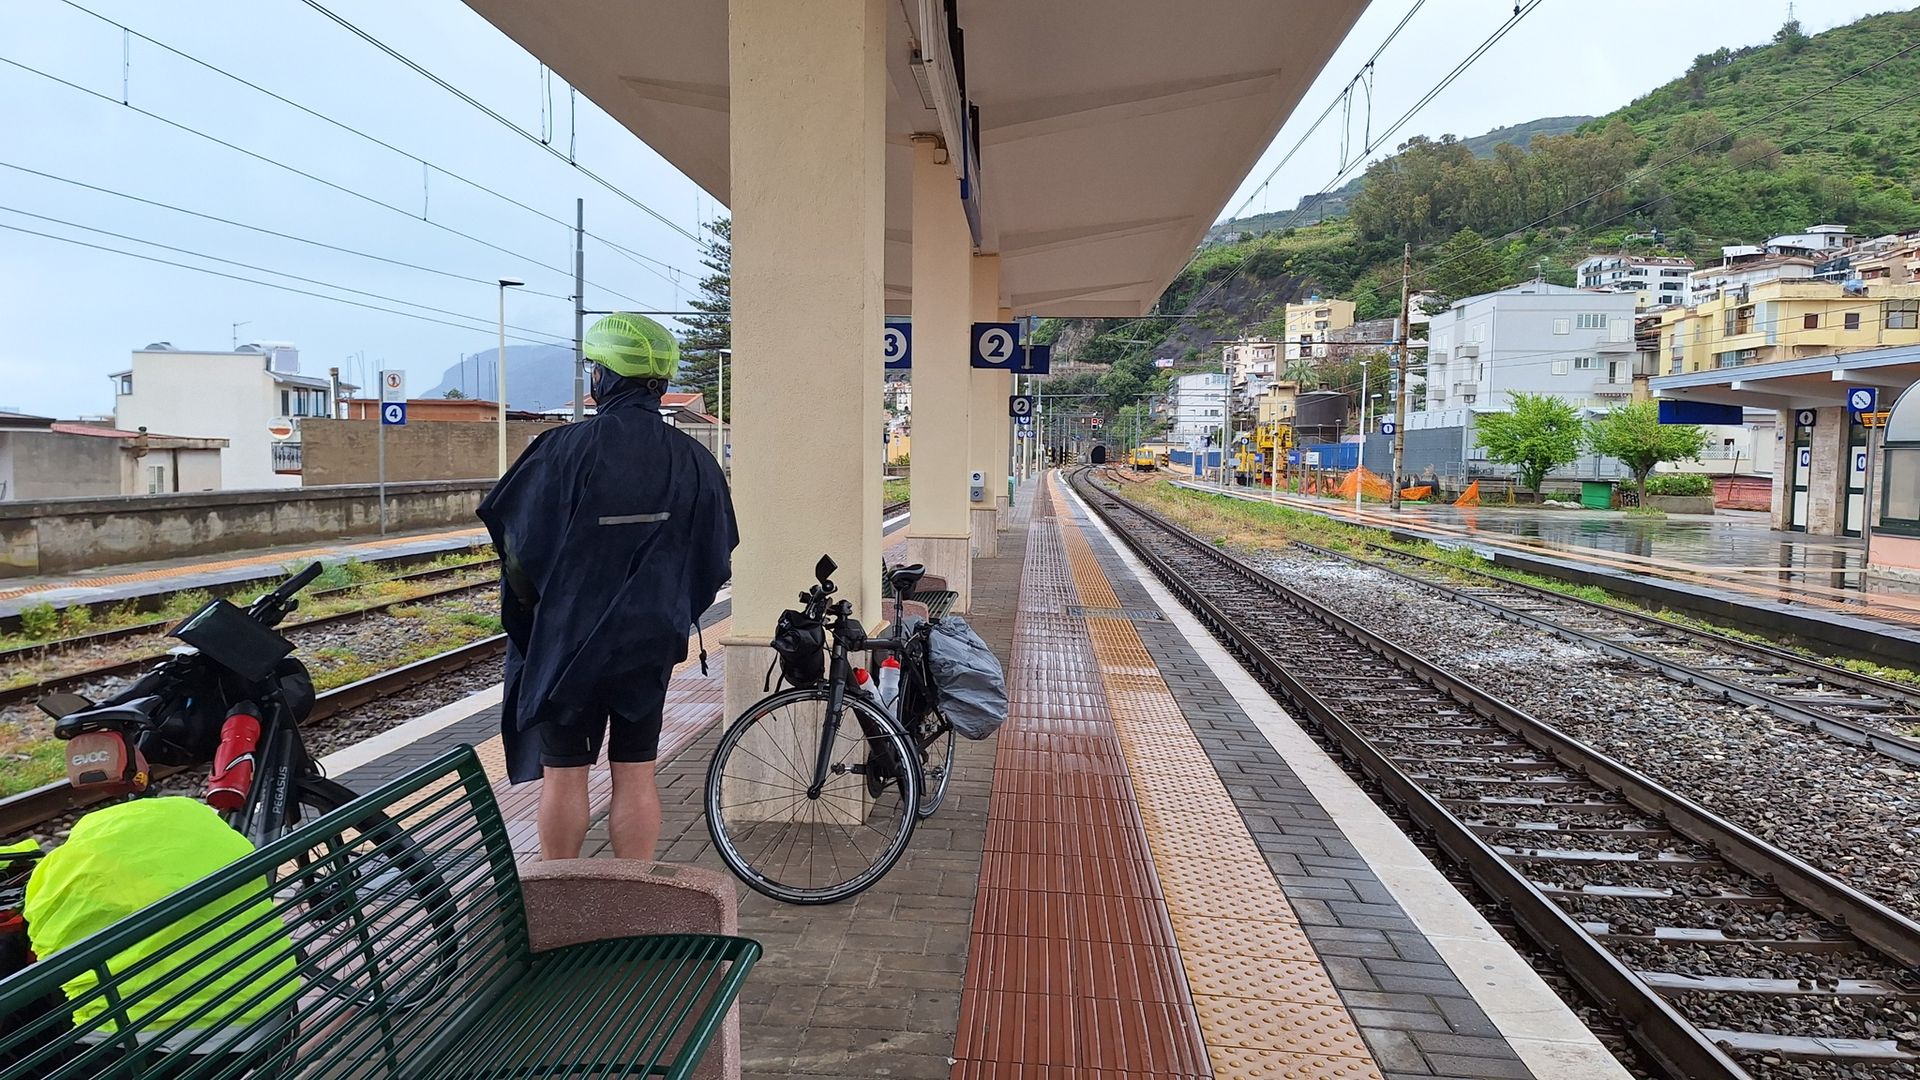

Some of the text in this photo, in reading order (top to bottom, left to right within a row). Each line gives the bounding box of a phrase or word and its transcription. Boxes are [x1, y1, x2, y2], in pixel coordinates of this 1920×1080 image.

[885, 334, 899, 357] 3
[987, 334, 1005, 357] 2
[389, 408, 398, 419] 4
[1017, 401, 1025, 411] 2
[72, 750, 108, 766] evoc
[272, 766, 288, 814] PEGASUS
